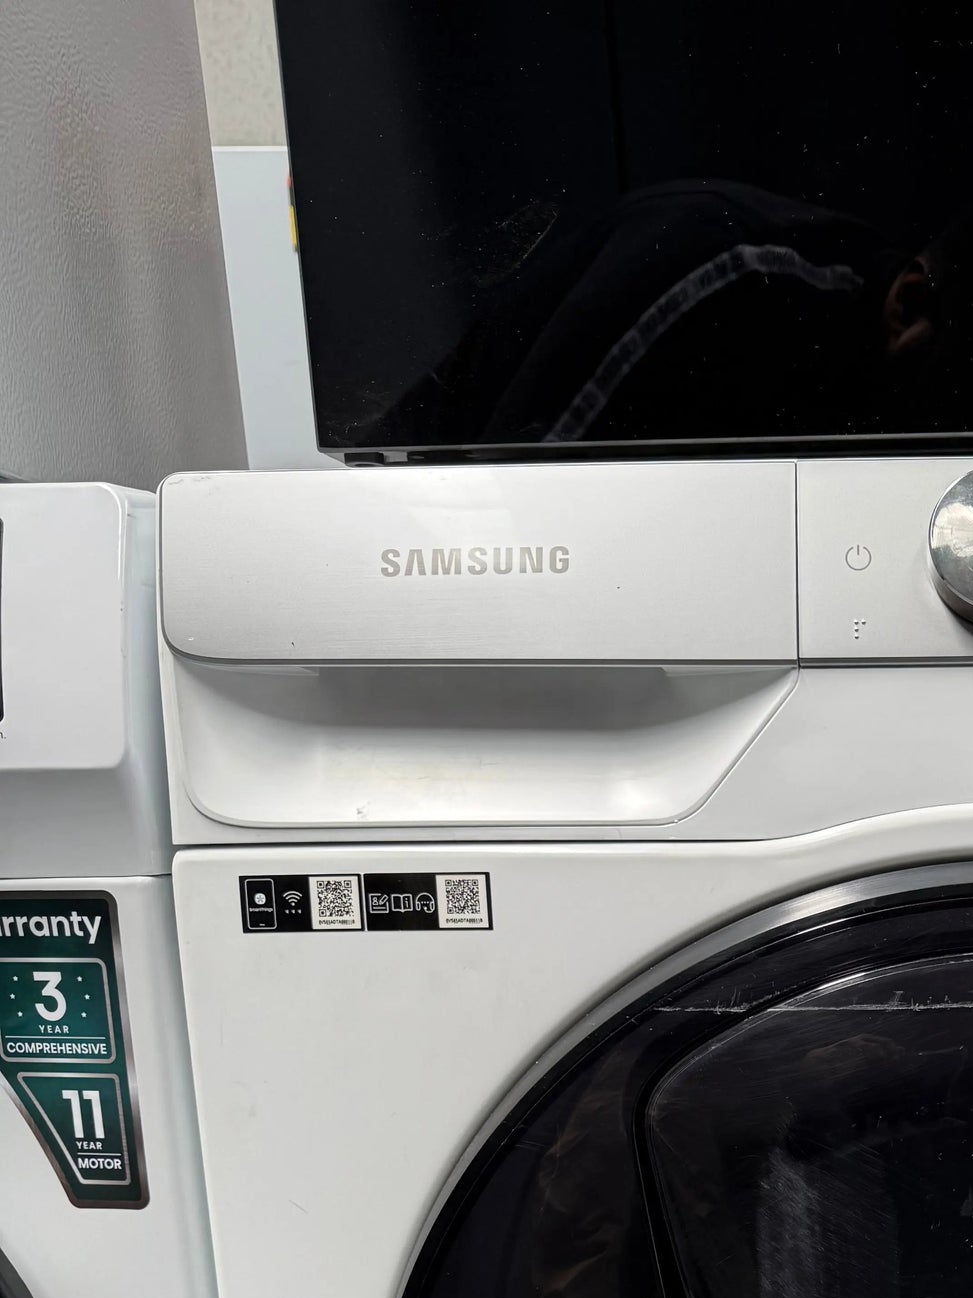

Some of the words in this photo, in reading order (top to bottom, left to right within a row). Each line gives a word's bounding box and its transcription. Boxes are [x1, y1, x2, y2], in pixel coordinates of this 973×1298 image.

[380, 546, 569, 577] SAMSUNG
[0, 911, 101, 944] rranty
[32, 971, 67, 1022] 3
[38, 1025, 69, 1034] YEAR
[7, 1042, 107, 1055] COMPREHENSIVE
[62, 1090, 105, 1139] 11
[76, 1141, 102, 1150] YEAR
[78, 1157, 122, 1170] MOTOR
